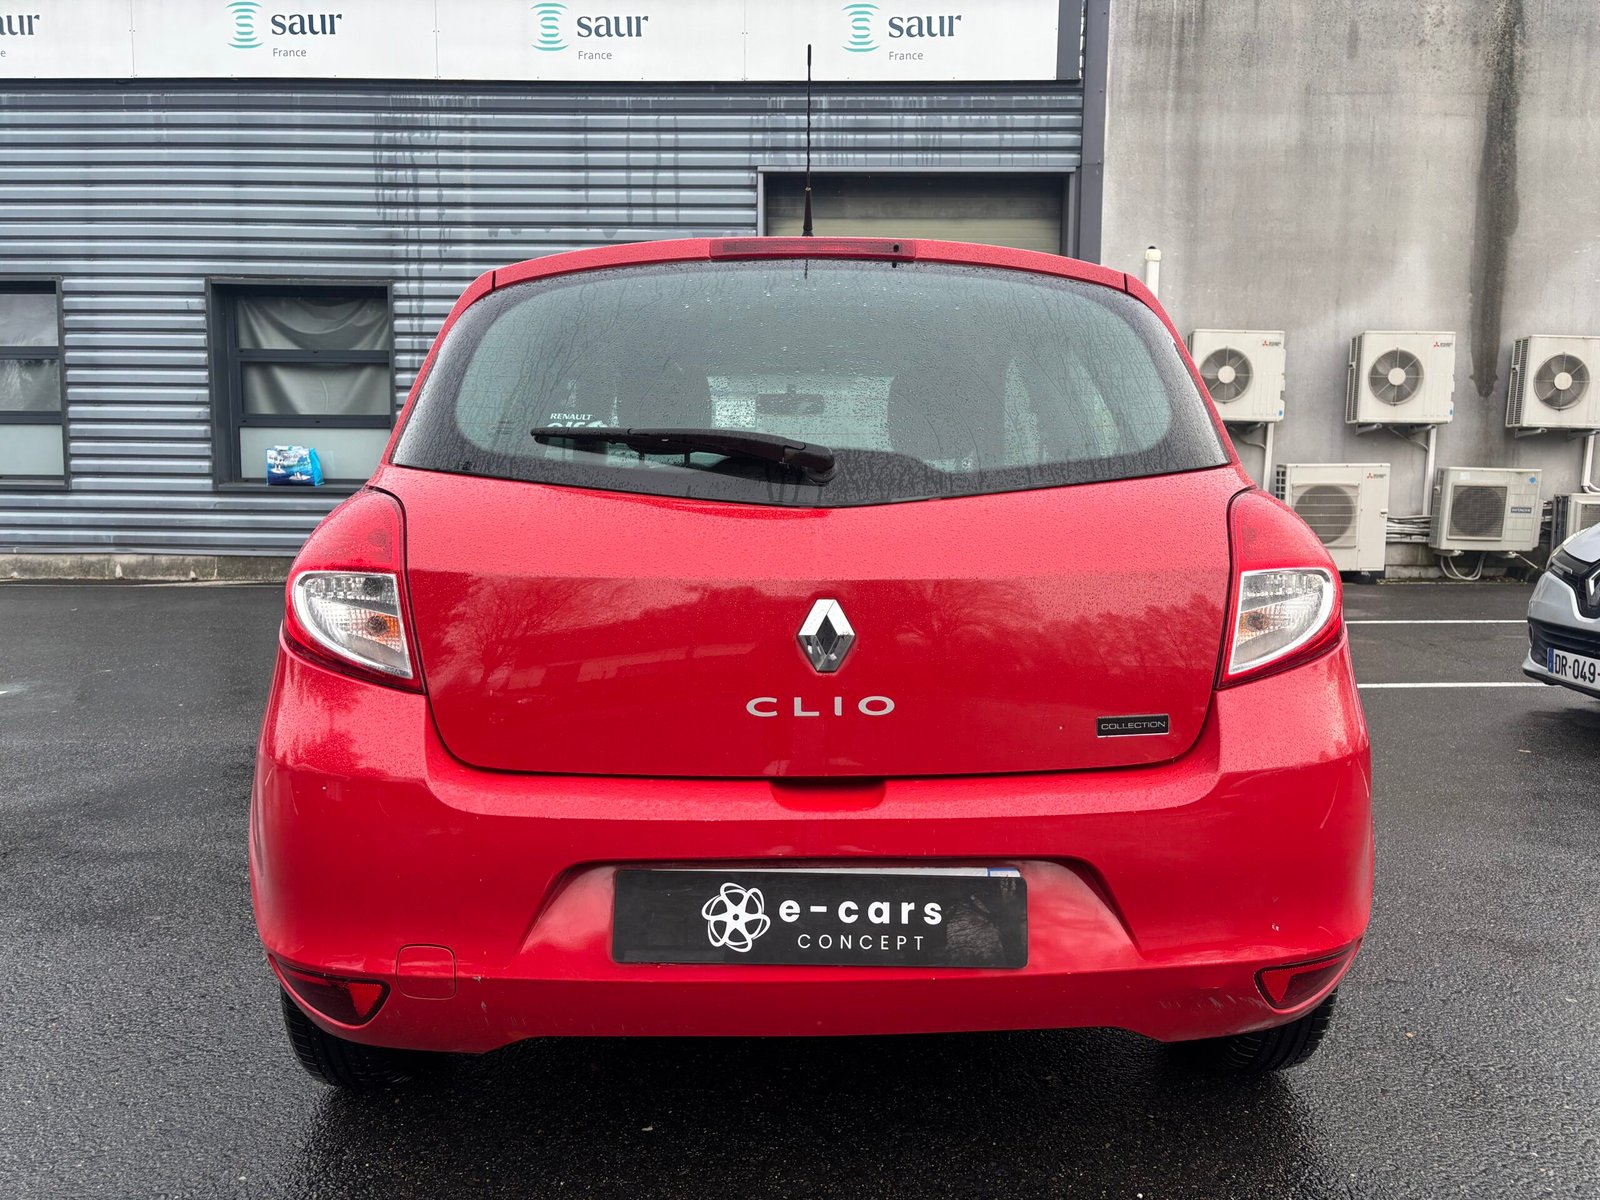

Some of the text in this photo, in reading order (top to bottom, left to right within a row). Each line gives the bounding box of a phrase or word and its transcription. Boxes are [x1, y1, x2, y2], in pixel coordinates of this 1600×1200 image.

[271, 14, 342, 35] saur
[577, 16, 649, 38] saur
[888, 15, 962, 38] saur
[272, 47, 307, 58] France
[578, 50, 613, 60] France
[888, 51, 924, 61] France
[550, 412, 592, 421] RENAULT
[746, 695, 896, 718] CLIO
[1100, 721, 1166, 730] COLLECTION
[778, 899, 943, 926] e-cars
[797, 933, 925, 951] CONCEPT
